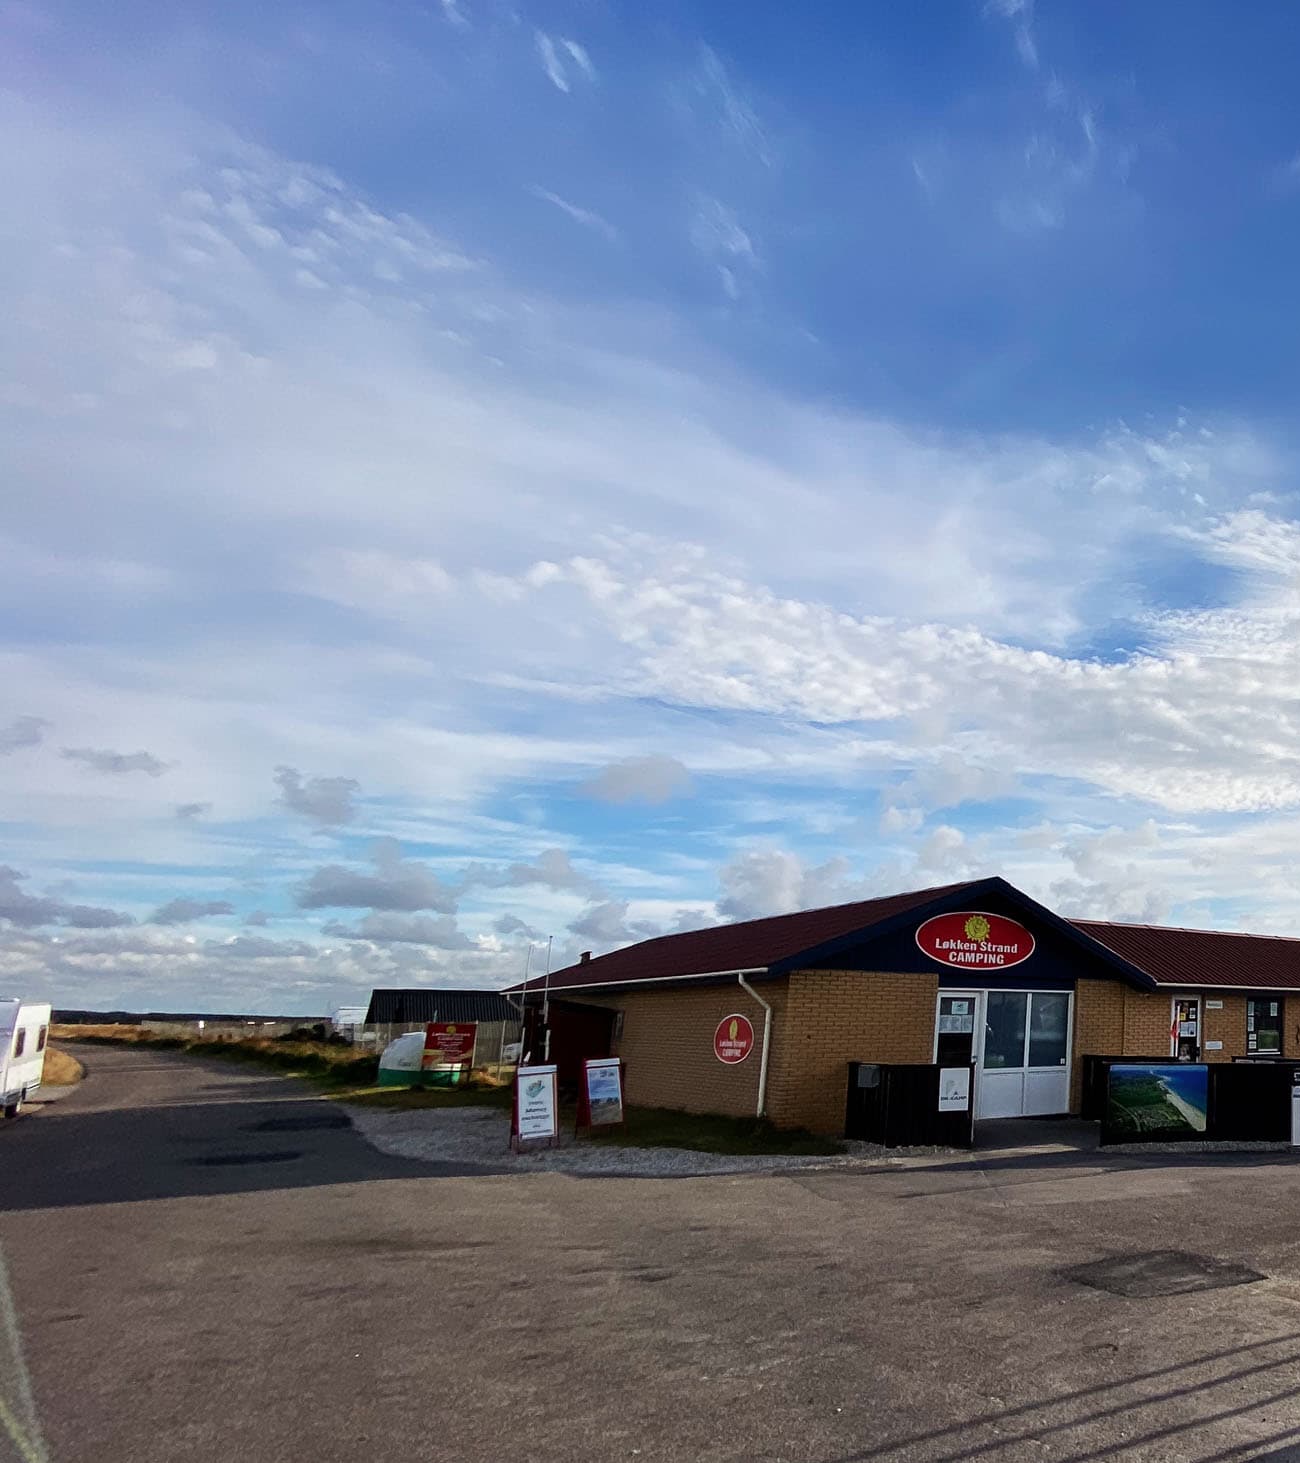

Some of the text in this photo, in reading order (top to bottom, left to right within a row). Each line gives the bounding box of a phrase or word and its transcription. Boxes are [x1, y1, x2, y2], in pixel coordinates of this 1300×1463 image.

[935, 938, 1018, 953] Løkken Strand
[949, 951, 1005, 964] CAMPING
